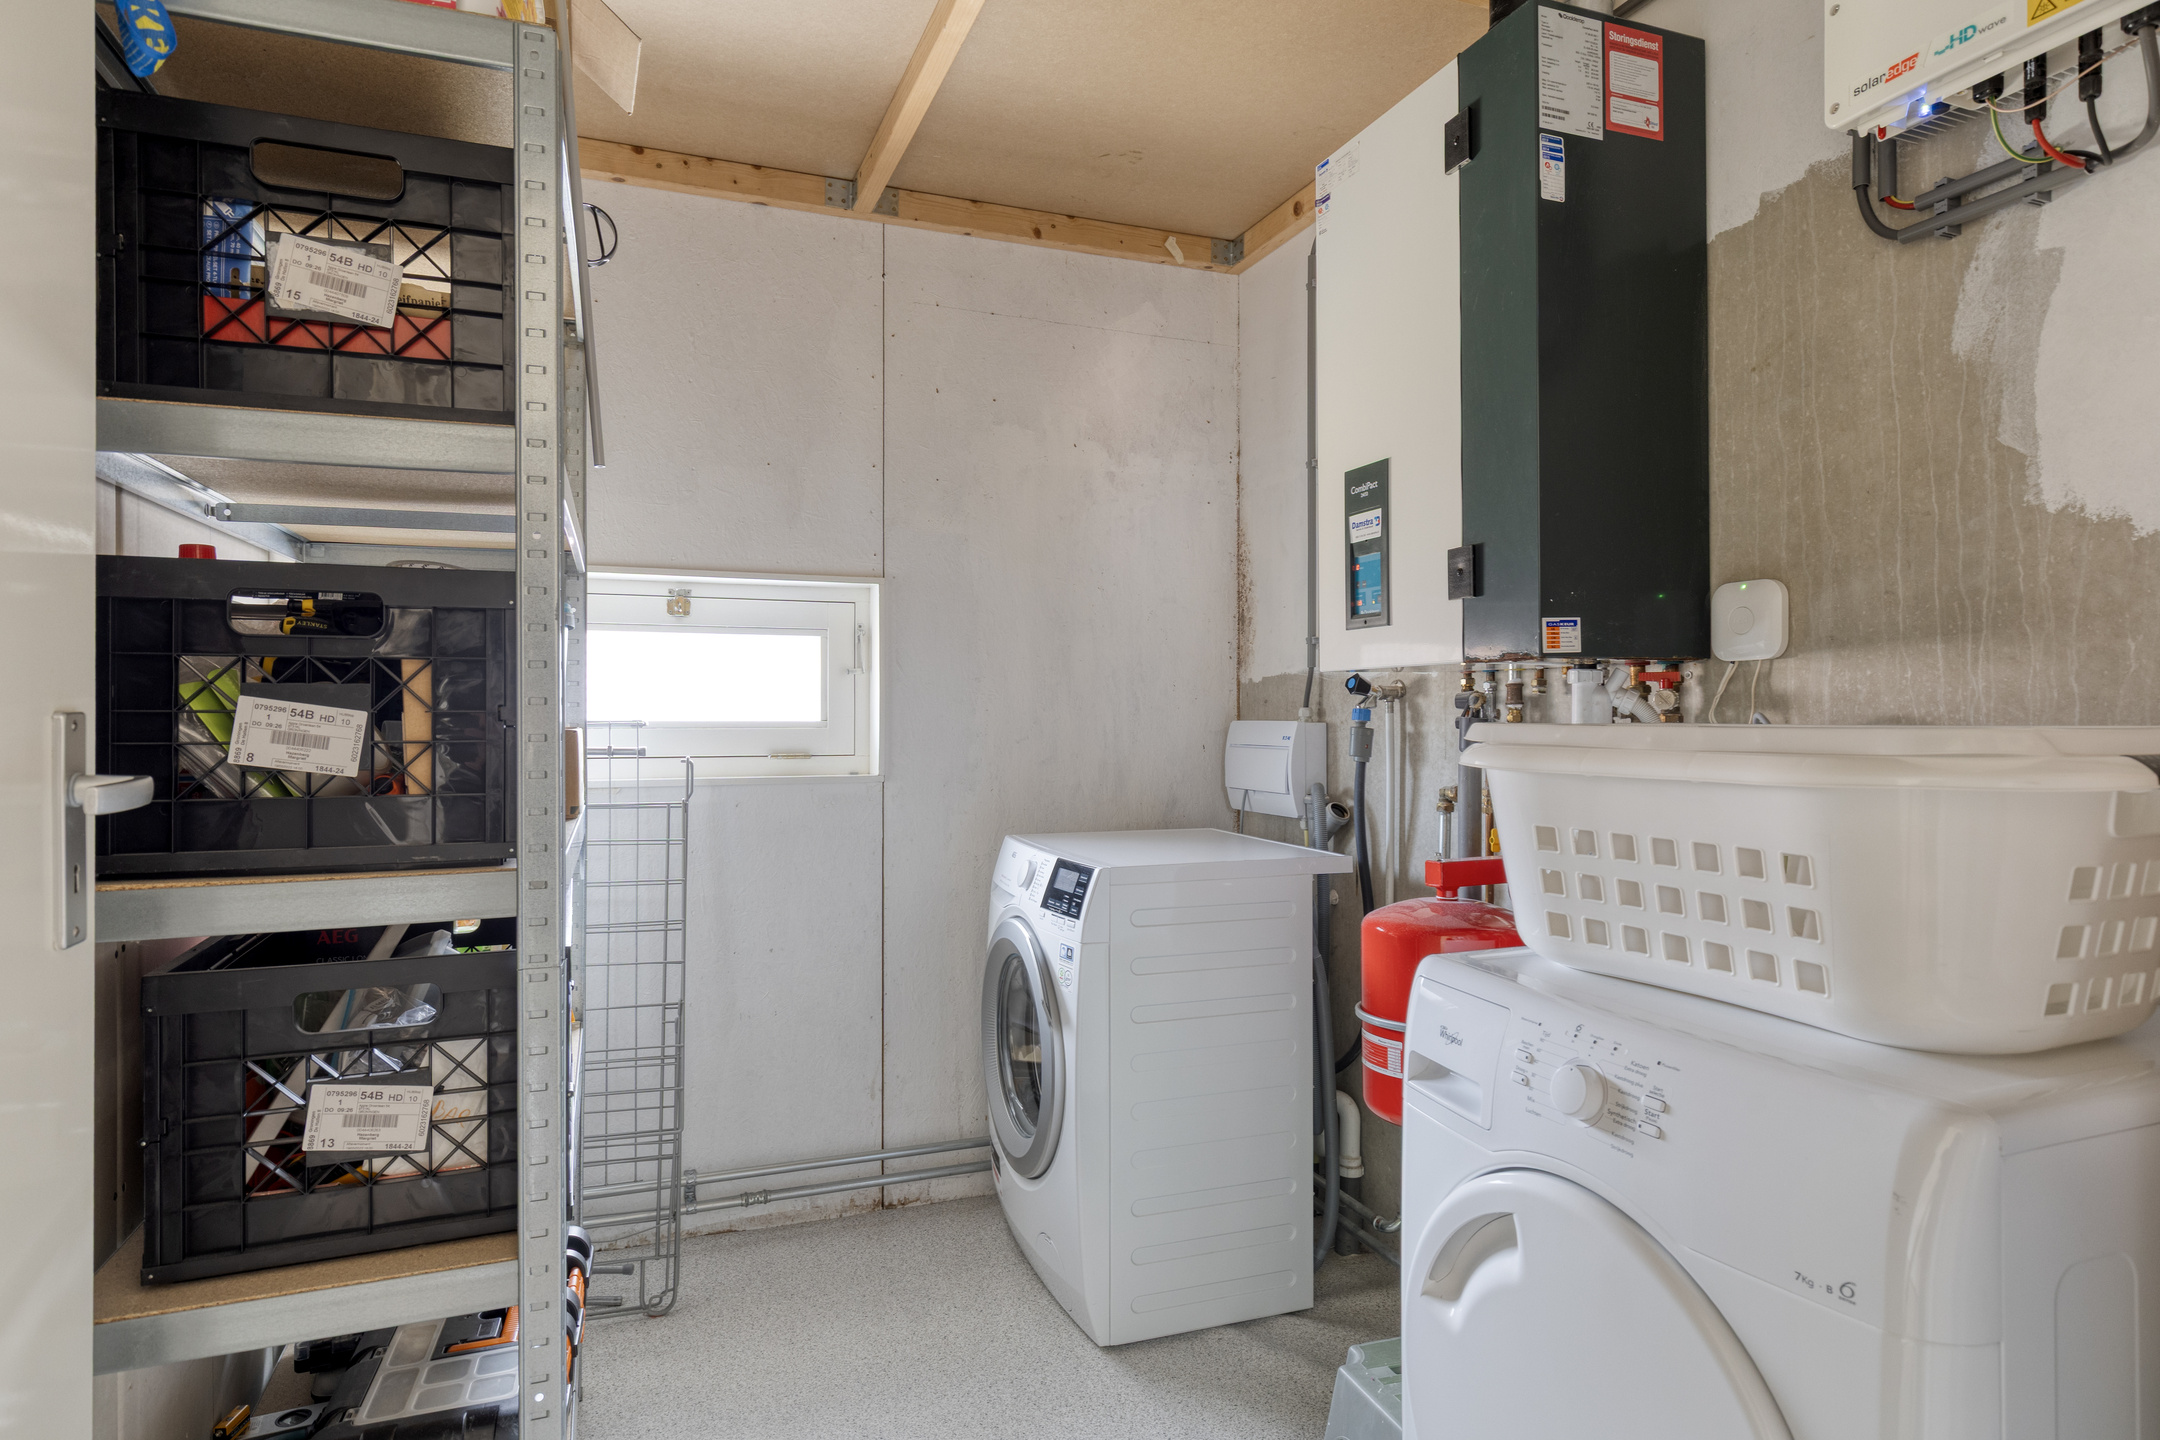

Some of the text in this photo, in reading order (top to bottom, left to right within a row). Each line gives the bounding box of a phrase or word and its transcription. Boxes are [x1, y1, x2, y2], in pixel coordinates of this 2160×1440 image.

[1950, 16, 2007, 50] HD wave
[1609, 30, 1659, 51] Storingsdienst
[1853, 56, 1918, 97] solaredge
[295, 242, 327, 257] 0795296
[304, 263, 322, 272] 09:26
[329, 252, 354, 267] 54B
[357, 263, 373, 273] HD
[378, 270, 388, 278] 10
[286, 289, 302, 300] 15
[386, 278, 400, 314] 6023162768
[352, 311, 380, 324] 1844-24
[1351, 481, 1378, 494] CombiPact
[1352, 519, 1373, 529] Damstra
[297, 621, 328, 630] STANLEY
[254, 703, 287, 713] 0795296
[290, 708, 314, 720] 54B
[319, 714, 335, 723] HD
[351, 724, 364, 762] 6023162768
[246, 752, 254, 762] 8
[315, 766, 344, 774] 1844-24
[317, 928, 359, 945] AEG
[1631, 1061, 1649, 1070] Katoen
[360, 1091, 383, 1100] 54B
[418, 1099, 430, 1136] 6023162768
[1607, 1108, 1636, 1123] Synthetisch
[1644, 1109, 1660, 1120] Start
[320, 1138, 335, 1148] 13
[1826, 1284, 1833, 1294] B
